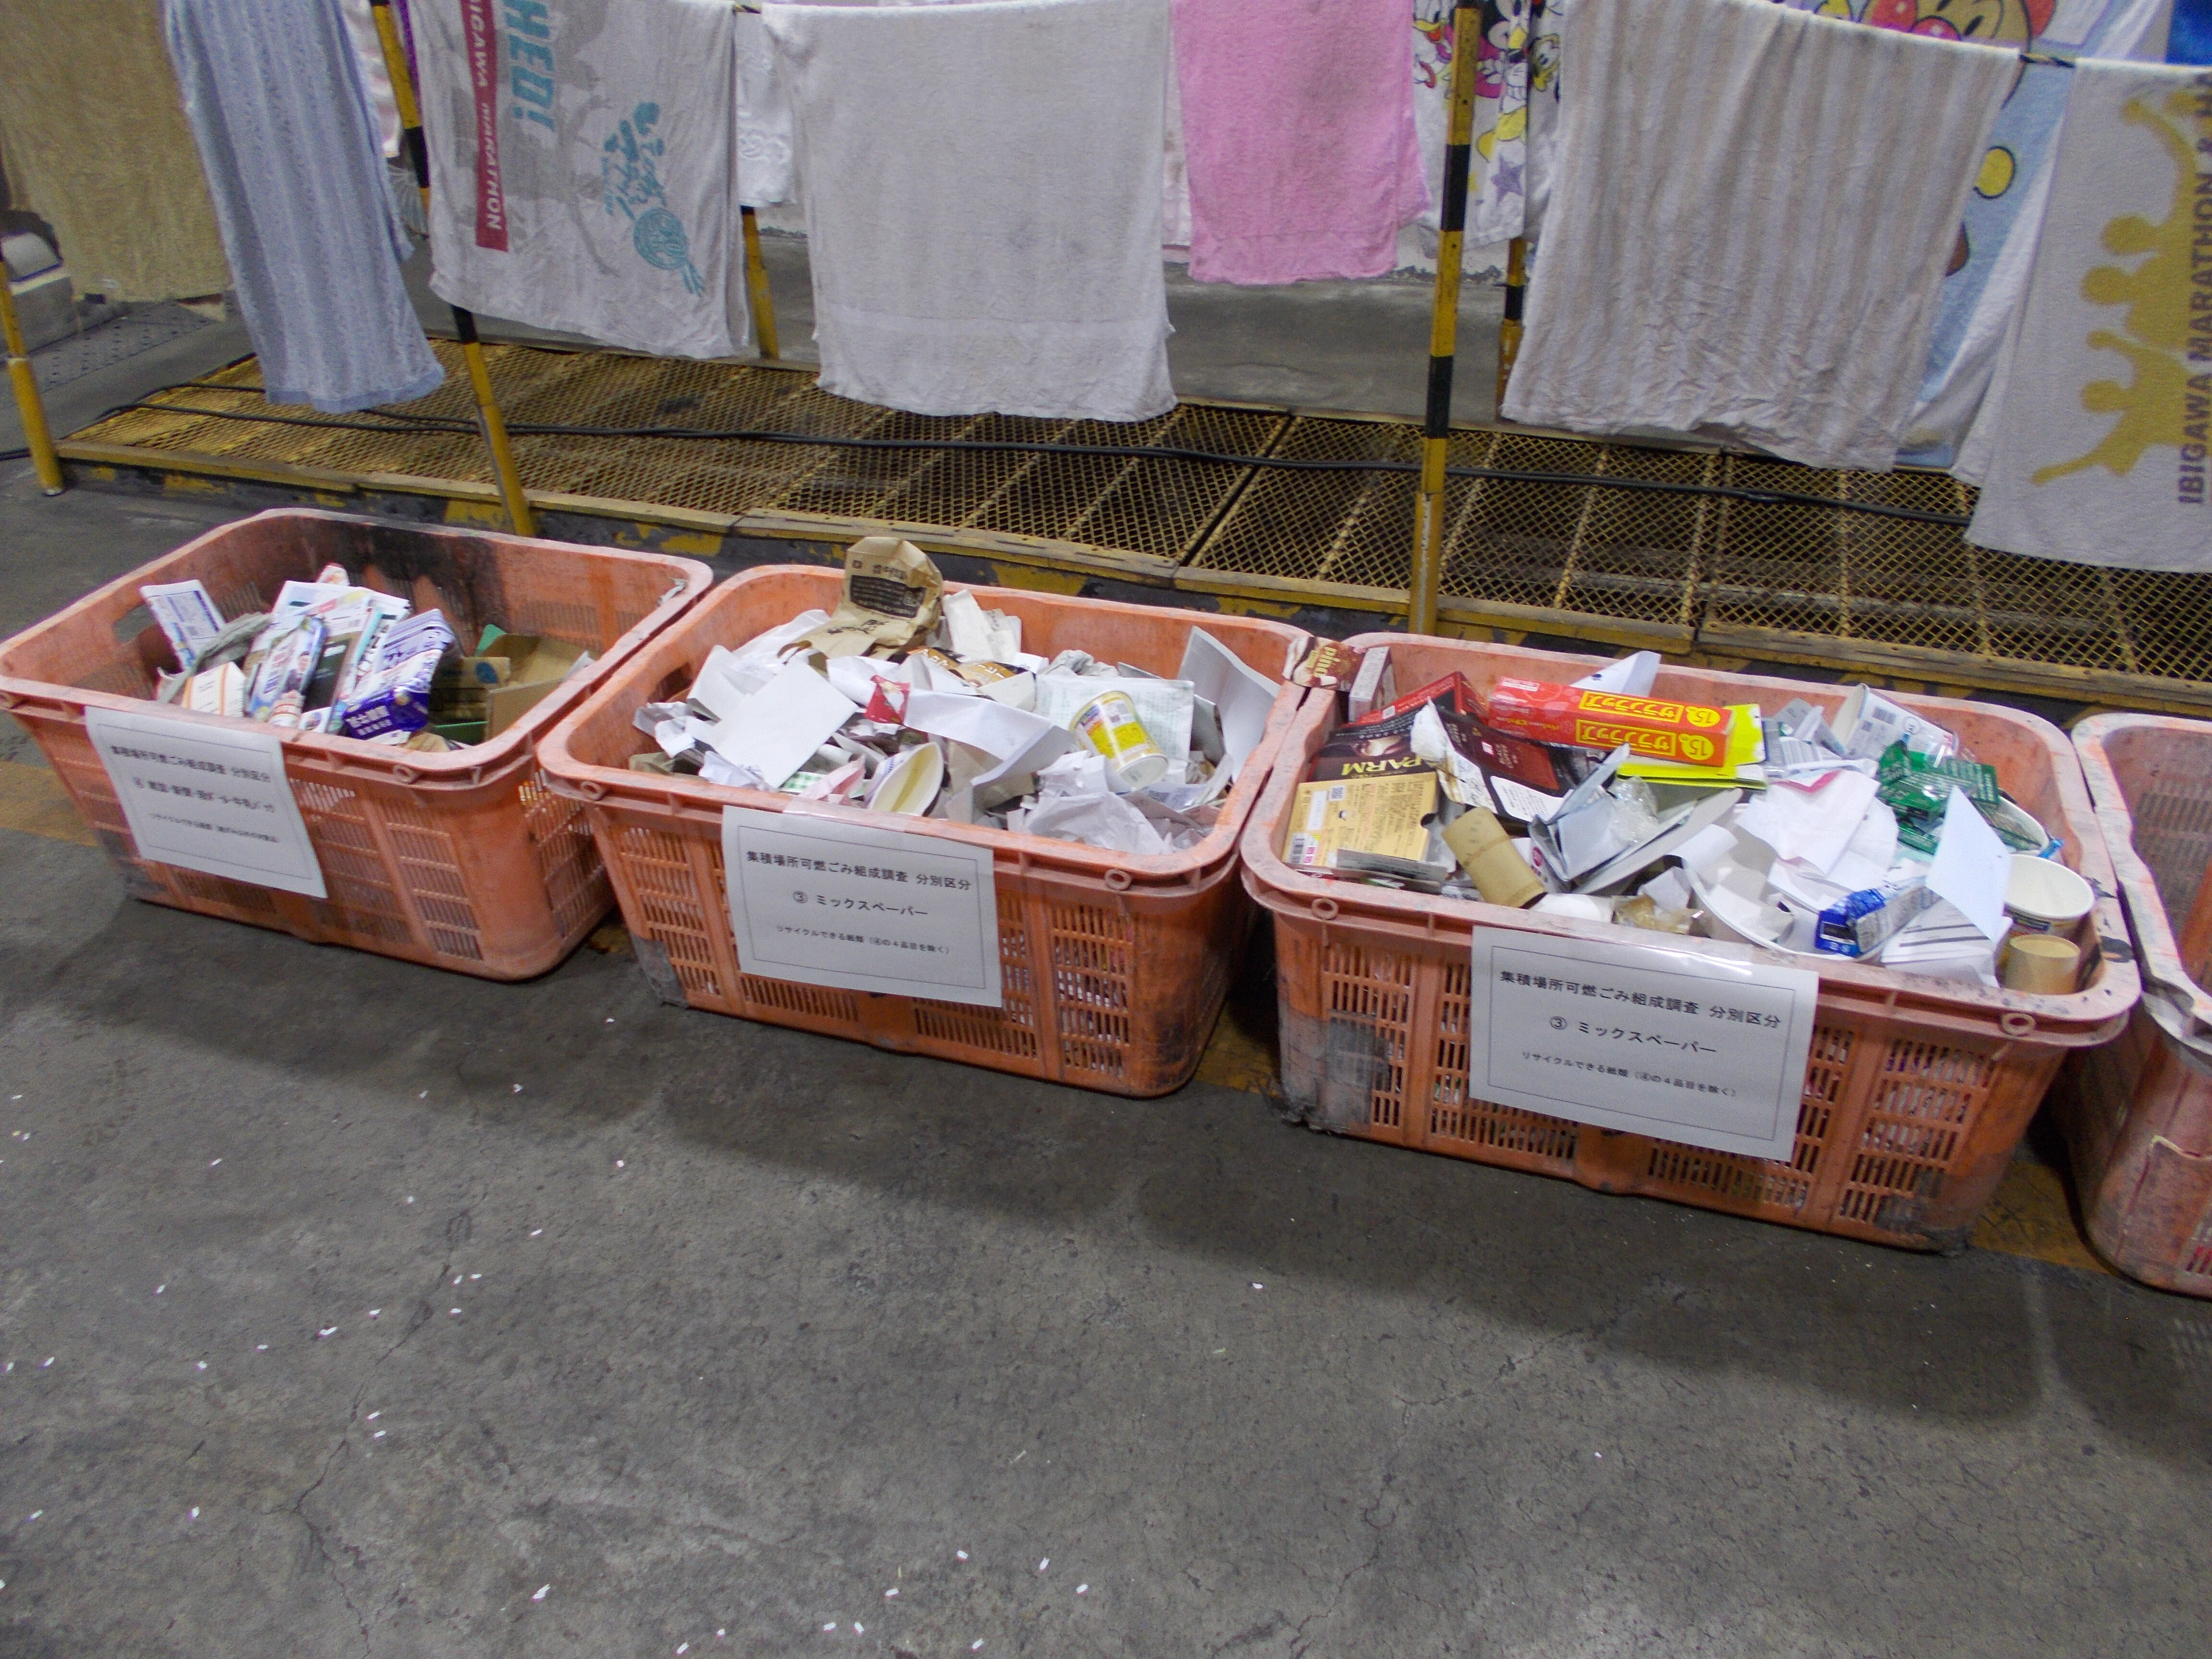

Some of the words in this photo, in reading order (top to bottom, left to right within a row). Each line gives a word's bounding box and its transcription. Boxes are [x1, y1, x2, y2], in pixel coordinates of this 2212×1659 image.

[468, 0, 489, 87] IGAWA
[481, 102, 502, 230] MARATHON
[2187, 170, 2212, 361] MARATHON
[2177, 373, 2212, 504] IBIGAWA
[1313, 646, 1341, 678] pino
[1585, 696, 1674, 718] サランラップ
[1694, 710, 1711, 723] 15
[1582, 726, 1669, 750] サランラップ
[1690, 738, 1708, 757] 15
[1341, 756, 1421, 776] PARM
[746, 851, 909, 883] 集積場所可燃ごみ組成調査
[916, 874, 972, 890] 分別区分
[793, 891, 808, 904] ③
[817, 895, 928, 916] ミックスペーパー
[1500, 970, 1700, 1015] 集積場所可燃ごみ組成調査
[1709, 1006, 1781, 1029] 分別区分
[1550, 1016, 1568, 1031] ③
[1578, 1022, 1717, 1053] ミックスペーパー
